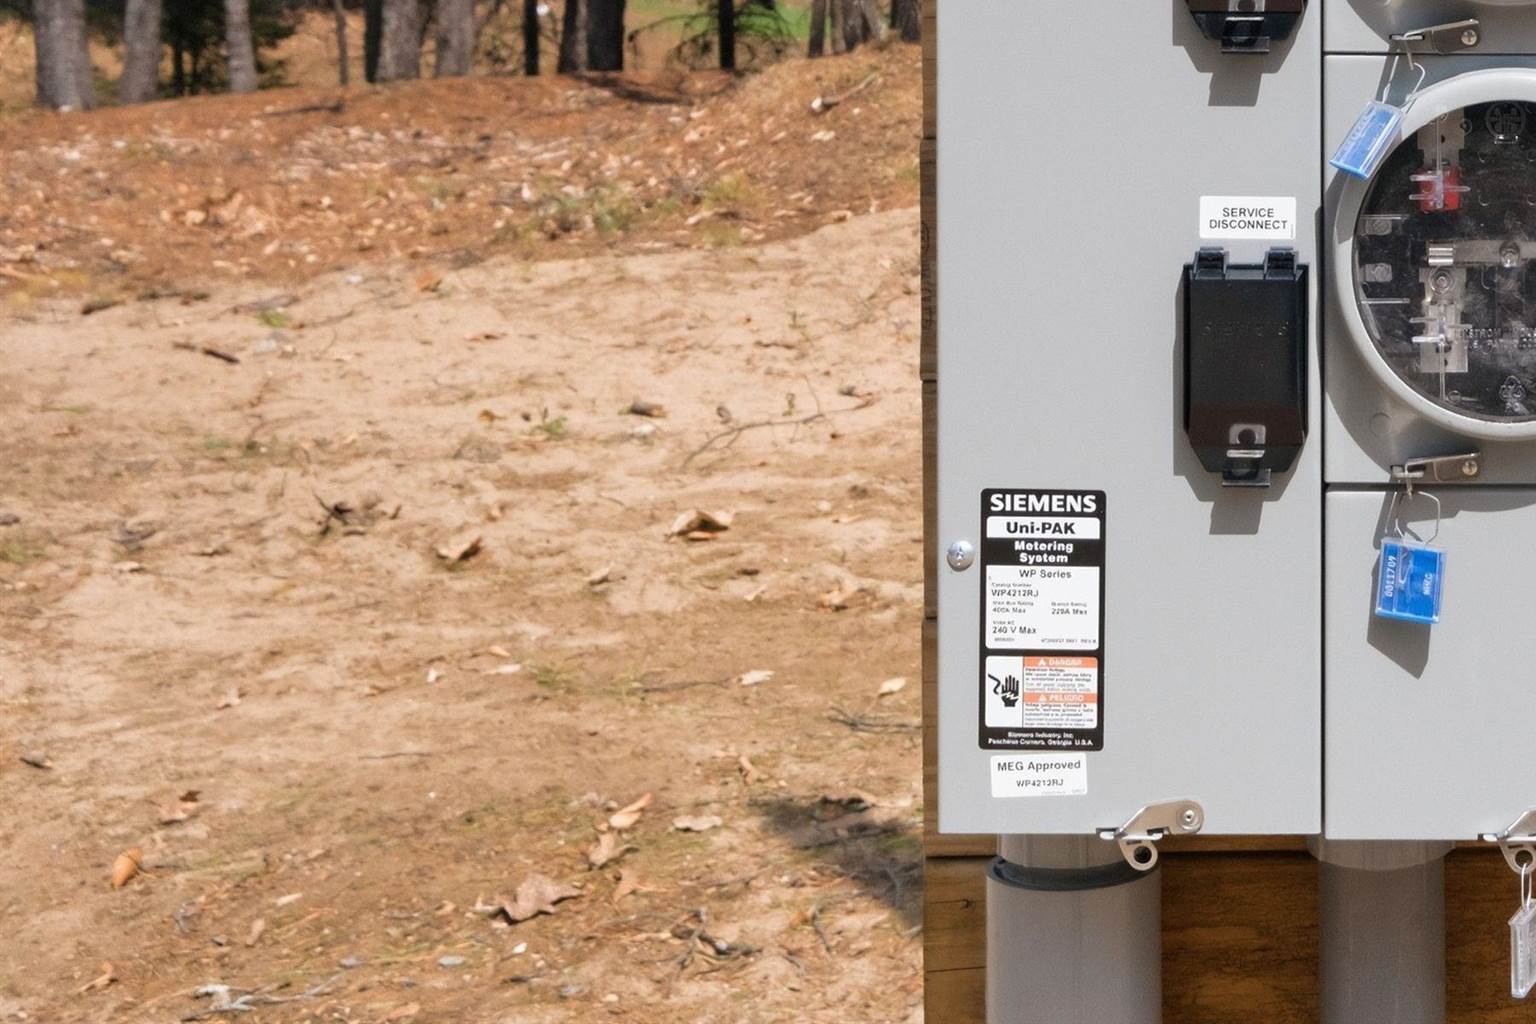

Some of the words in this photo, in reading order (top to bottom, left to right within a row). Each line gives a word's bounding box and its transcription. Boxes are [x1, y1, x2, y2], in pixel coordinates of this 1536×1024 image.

[1222, 207, 1275, 218] SERVICE
[1208, 219, 1288, 230] DISCONNECT
[990, 493, 1097, 513] SIEMENS
[1005, 521, 1076, 535] Uni-PAK
[1013, 540, 1074, 553] Metering
[1019, 552, 1069, 564] System
[1018, 569, 1037, 579] WP
[1039, 569, 1072, 579] Series
[991, 589, 1039, 598] WP4212RJ
[992, 626, 1008, 634] 240
[1010, 626, 1017, 634] V
[1019, 626, 1037, 634] Max
[997, 761, 1024, 771] MEG
[1027, 760, 1081, 772] Approved
[1016, 779, 1064, 787] WP4212RJ
